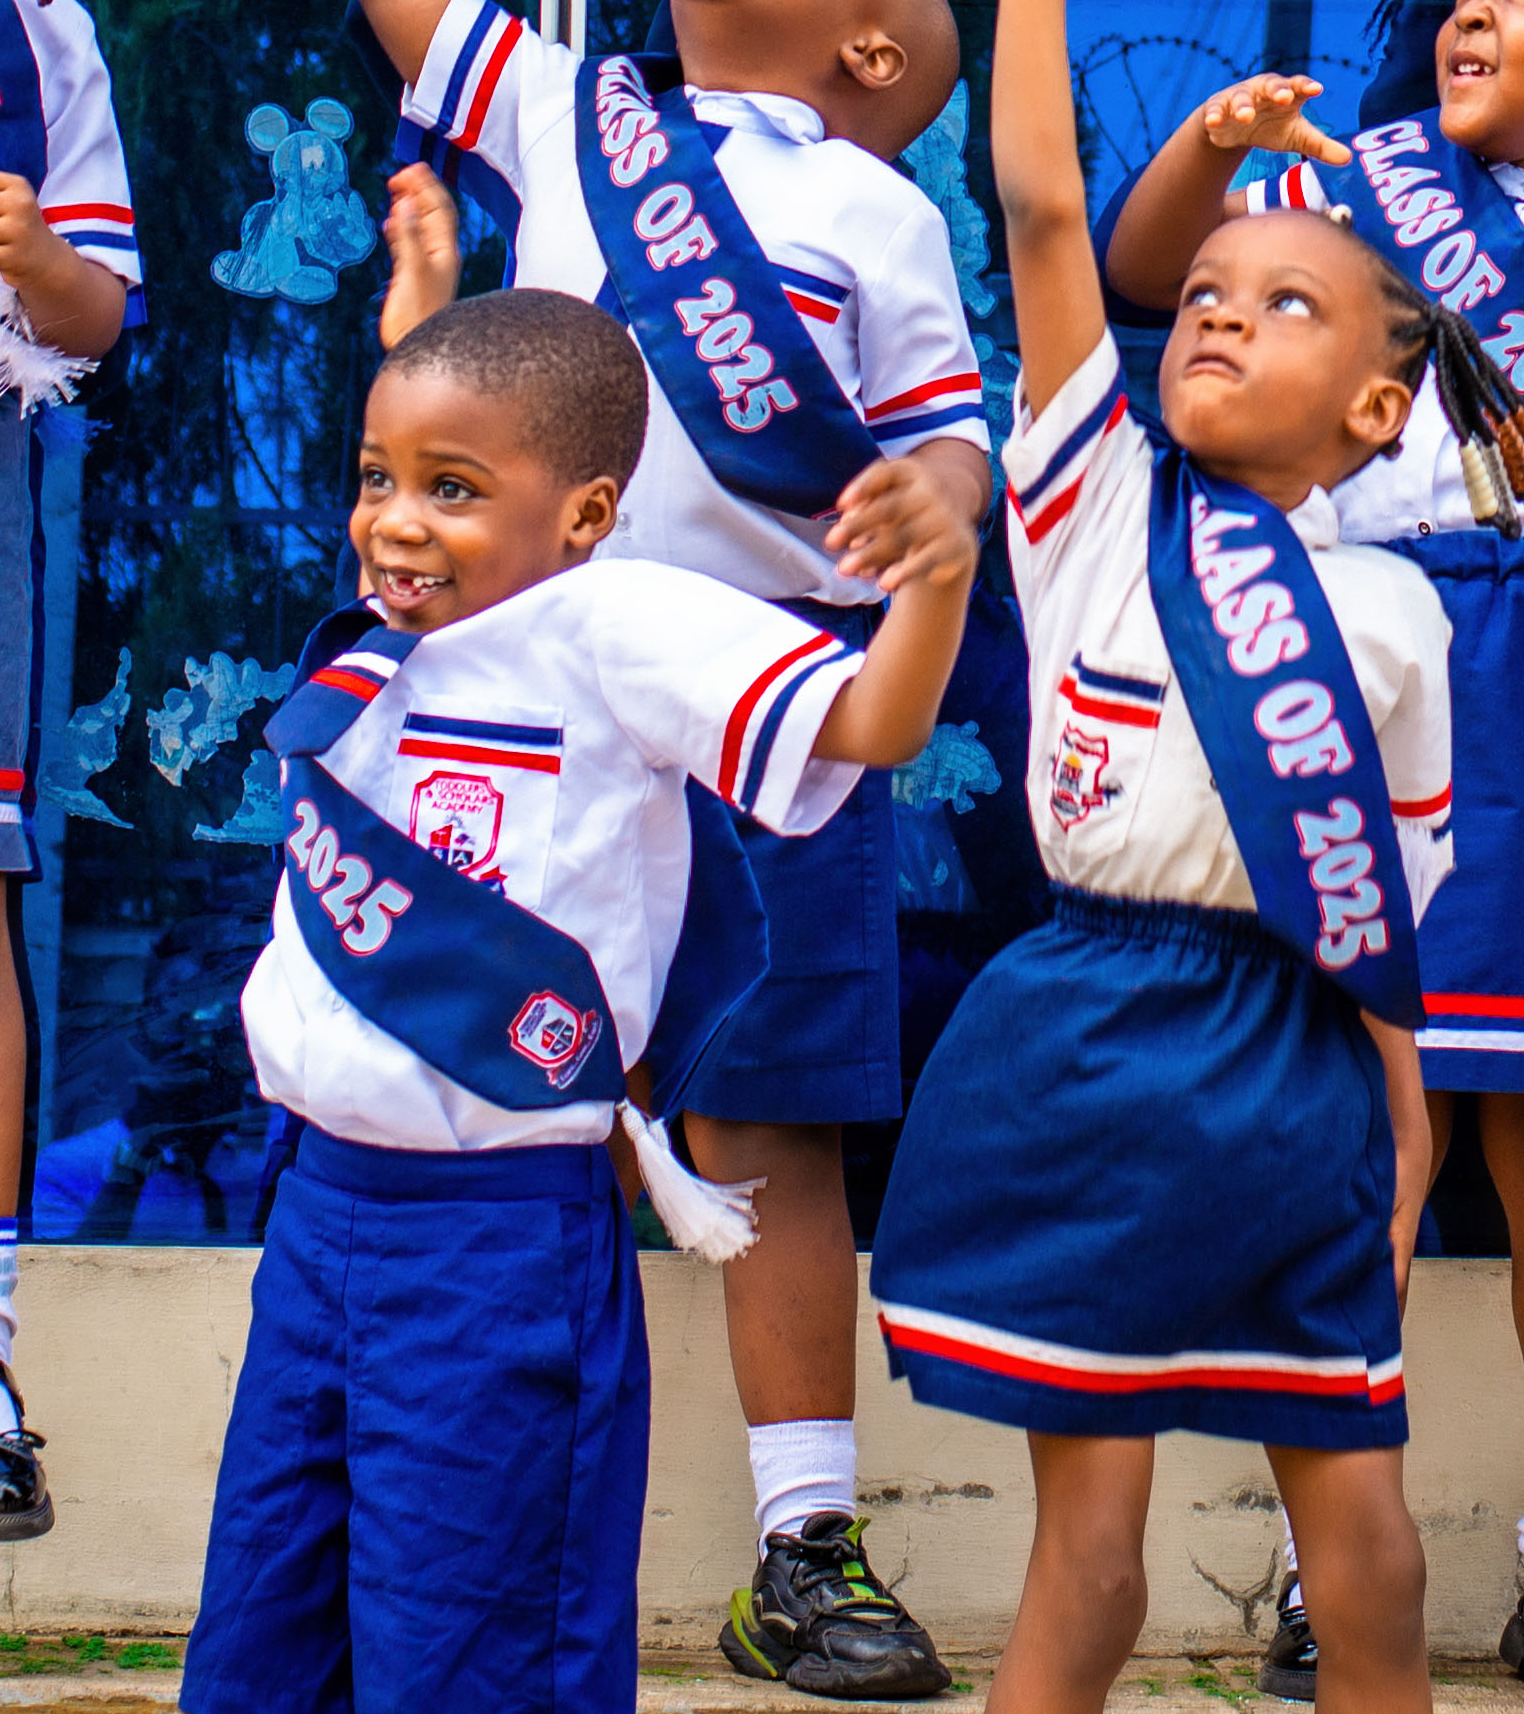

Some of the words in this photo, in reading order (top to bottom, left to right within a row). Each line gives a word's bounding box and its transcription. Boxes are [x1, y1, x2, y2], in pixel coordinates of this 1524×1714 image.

[596, 55, 669, 187] CLASS
[634, 183, 718, 271] OF
[1352, 120, 1464, 247] CLASS
[1421, 230, 1506, 313] OF
[674, 278, 799, 433] 2025
[1254, 679, 1355, 778] OF
[288, 798, 413, 956] 2025
[1294, 797, 1390, 971] 2025
